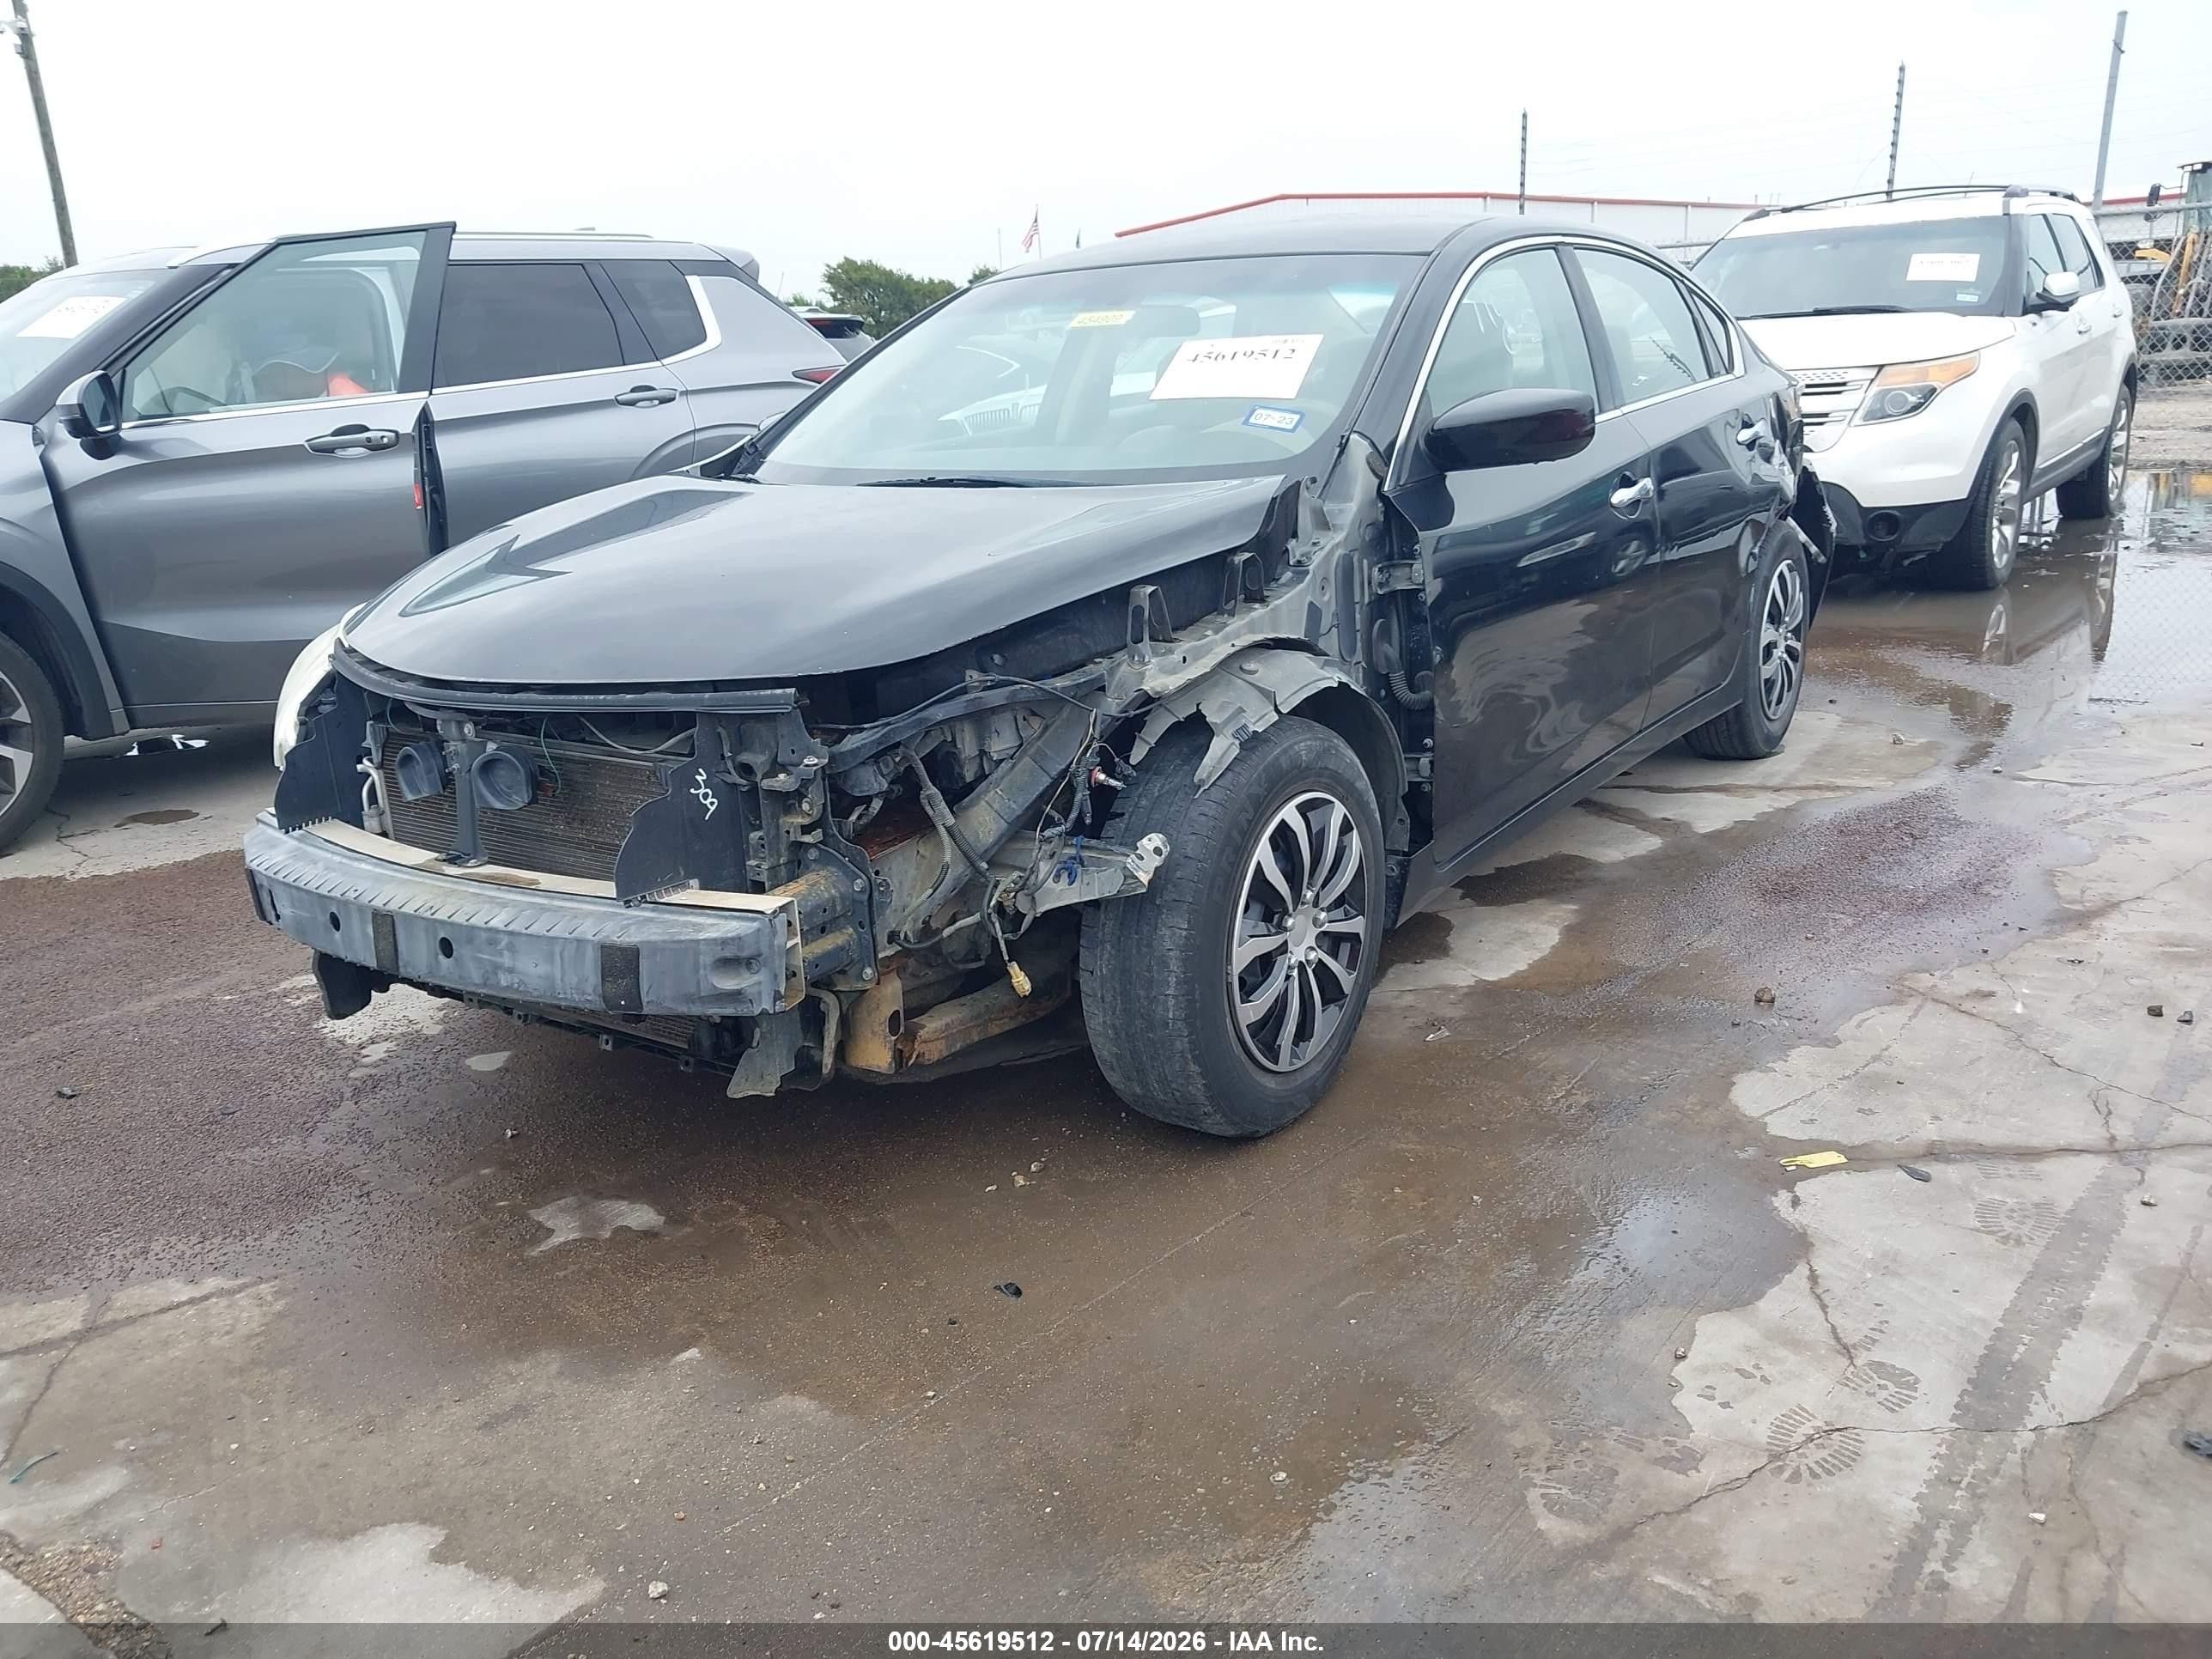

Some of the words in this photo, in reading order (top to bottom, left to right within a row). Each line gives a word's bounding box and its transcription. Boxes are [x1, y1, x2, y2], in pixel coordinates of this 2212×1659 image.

[1187, 349, 1296, 363] 45619512
[1254, 412, 1295, 426] 07-23
[690, 768, 718, 820] 309
